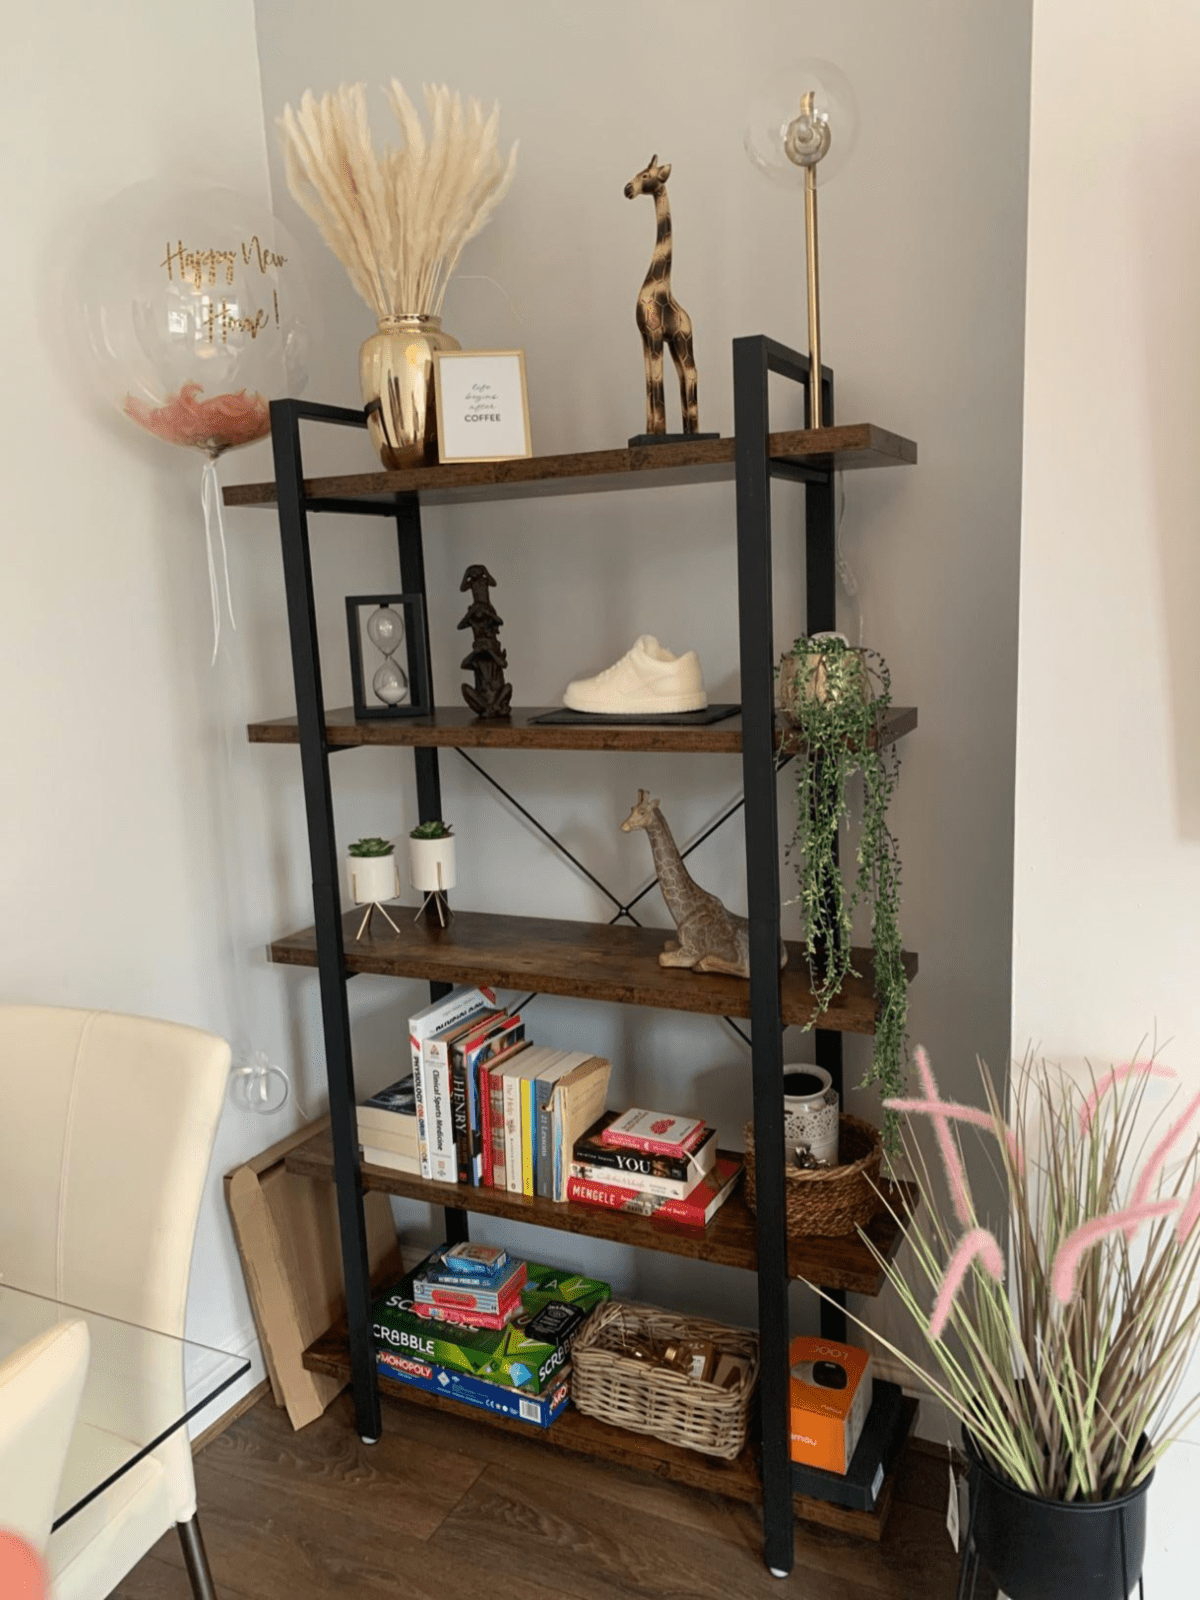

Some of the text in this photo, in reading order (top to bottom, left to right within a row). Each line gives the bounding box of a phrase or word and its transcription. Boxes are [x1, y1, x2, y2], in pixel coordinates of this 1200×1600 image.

[160, 236, 288, 289] Happy New
[464, 413, 501, 422] COFFEE
[413, 1056, 424, 1104] PHYSIOLOGY
[432, 1069, 442, 1096] Clinical
[434, 1096, 443, 1119] Sports
[453, 1080, 467, 1134] HENRY
[435, 1119, 444, 1151] Medicine
[616, 1155, 650, 1174] YOU
[573, 1185, 616, 1206] MENGELE
[373, 1324, 436, 1355] CRABBLE
[381, 1352, 432, 1379] MONOPOLY
[538, 1328, 578, 1383] SCRABB
